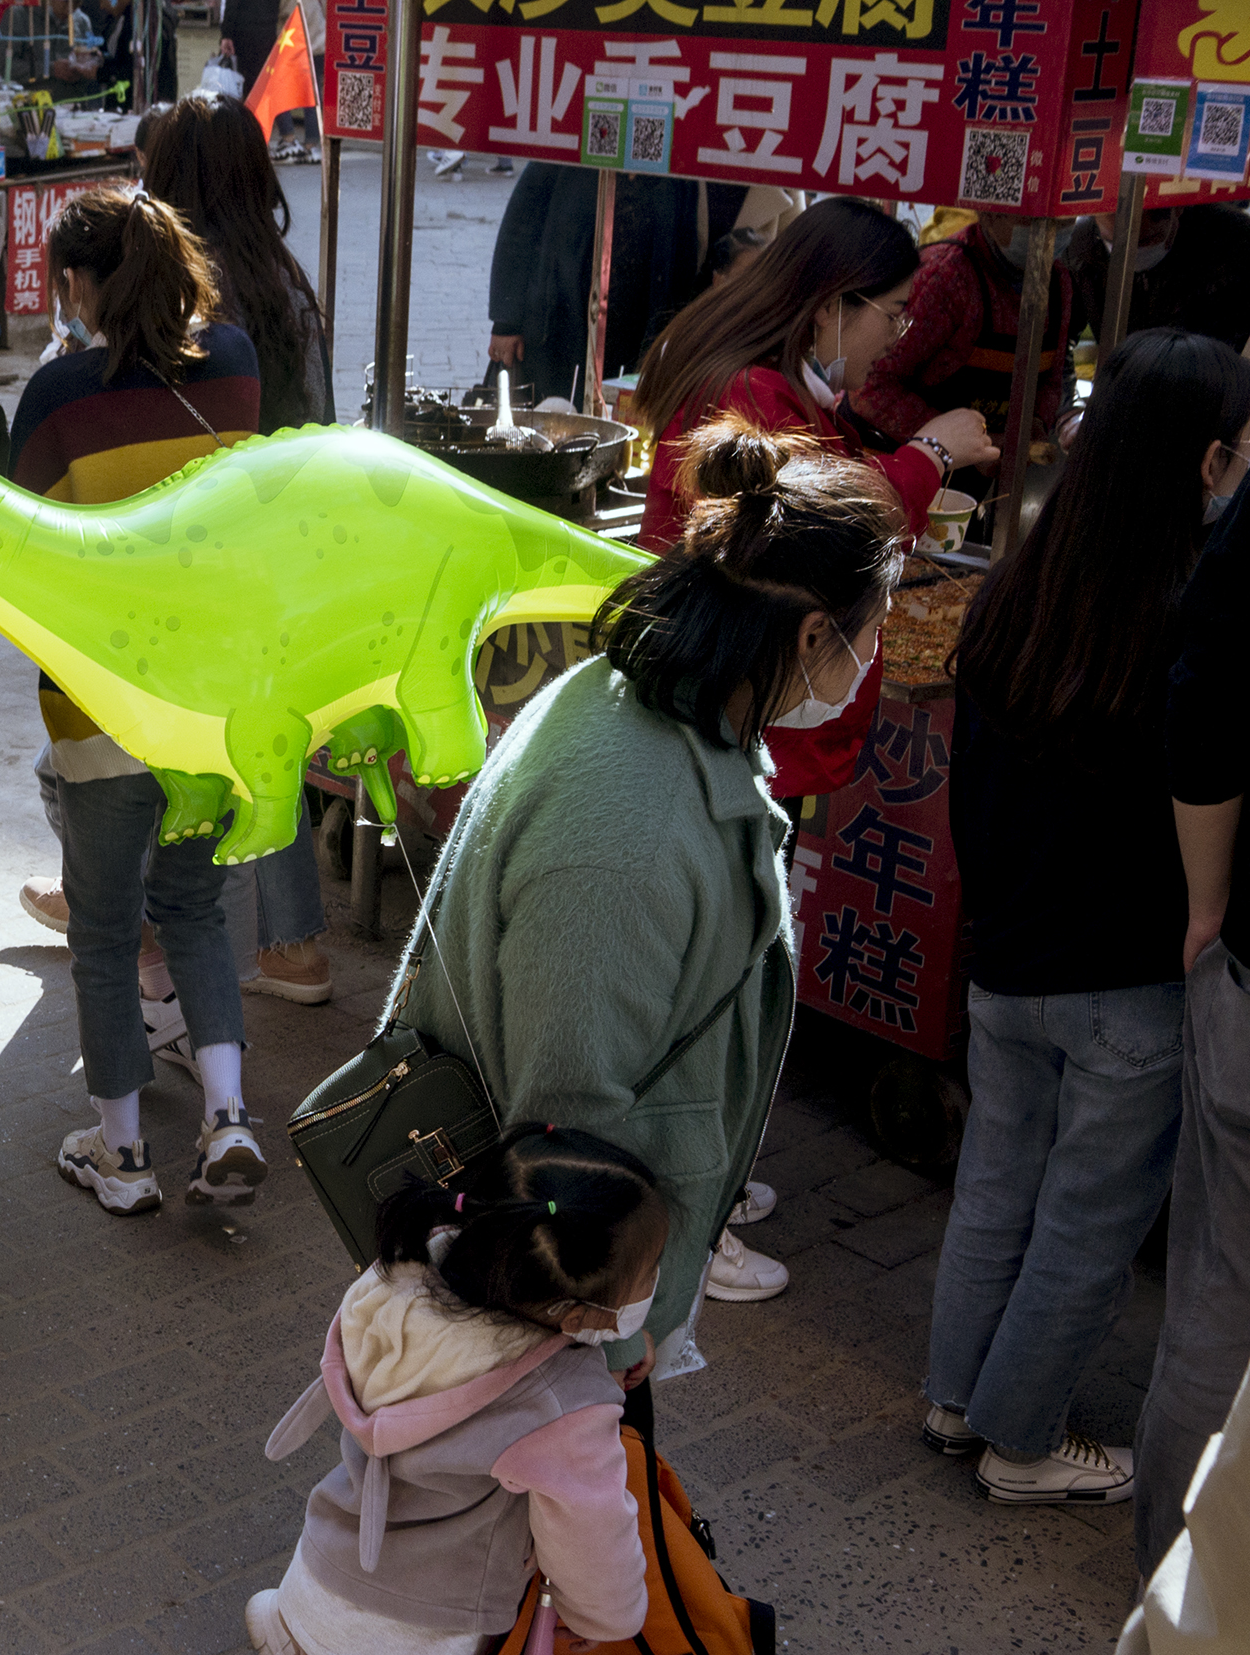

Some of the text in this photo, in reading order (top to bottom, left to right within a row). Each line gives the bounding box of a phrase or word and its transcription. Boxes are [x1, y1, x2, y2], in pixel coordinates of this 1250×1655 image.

[952, 0, 1047, 122] 年糕
[1060, 9, 1120, 204] 土豆
[13, 187, 86, 245] 钢化
[1027, 150, 1043, 193] 微信
[14, 248, 42, 311] 手机壳
[813, 700, 949, 1033] 炒年糕
